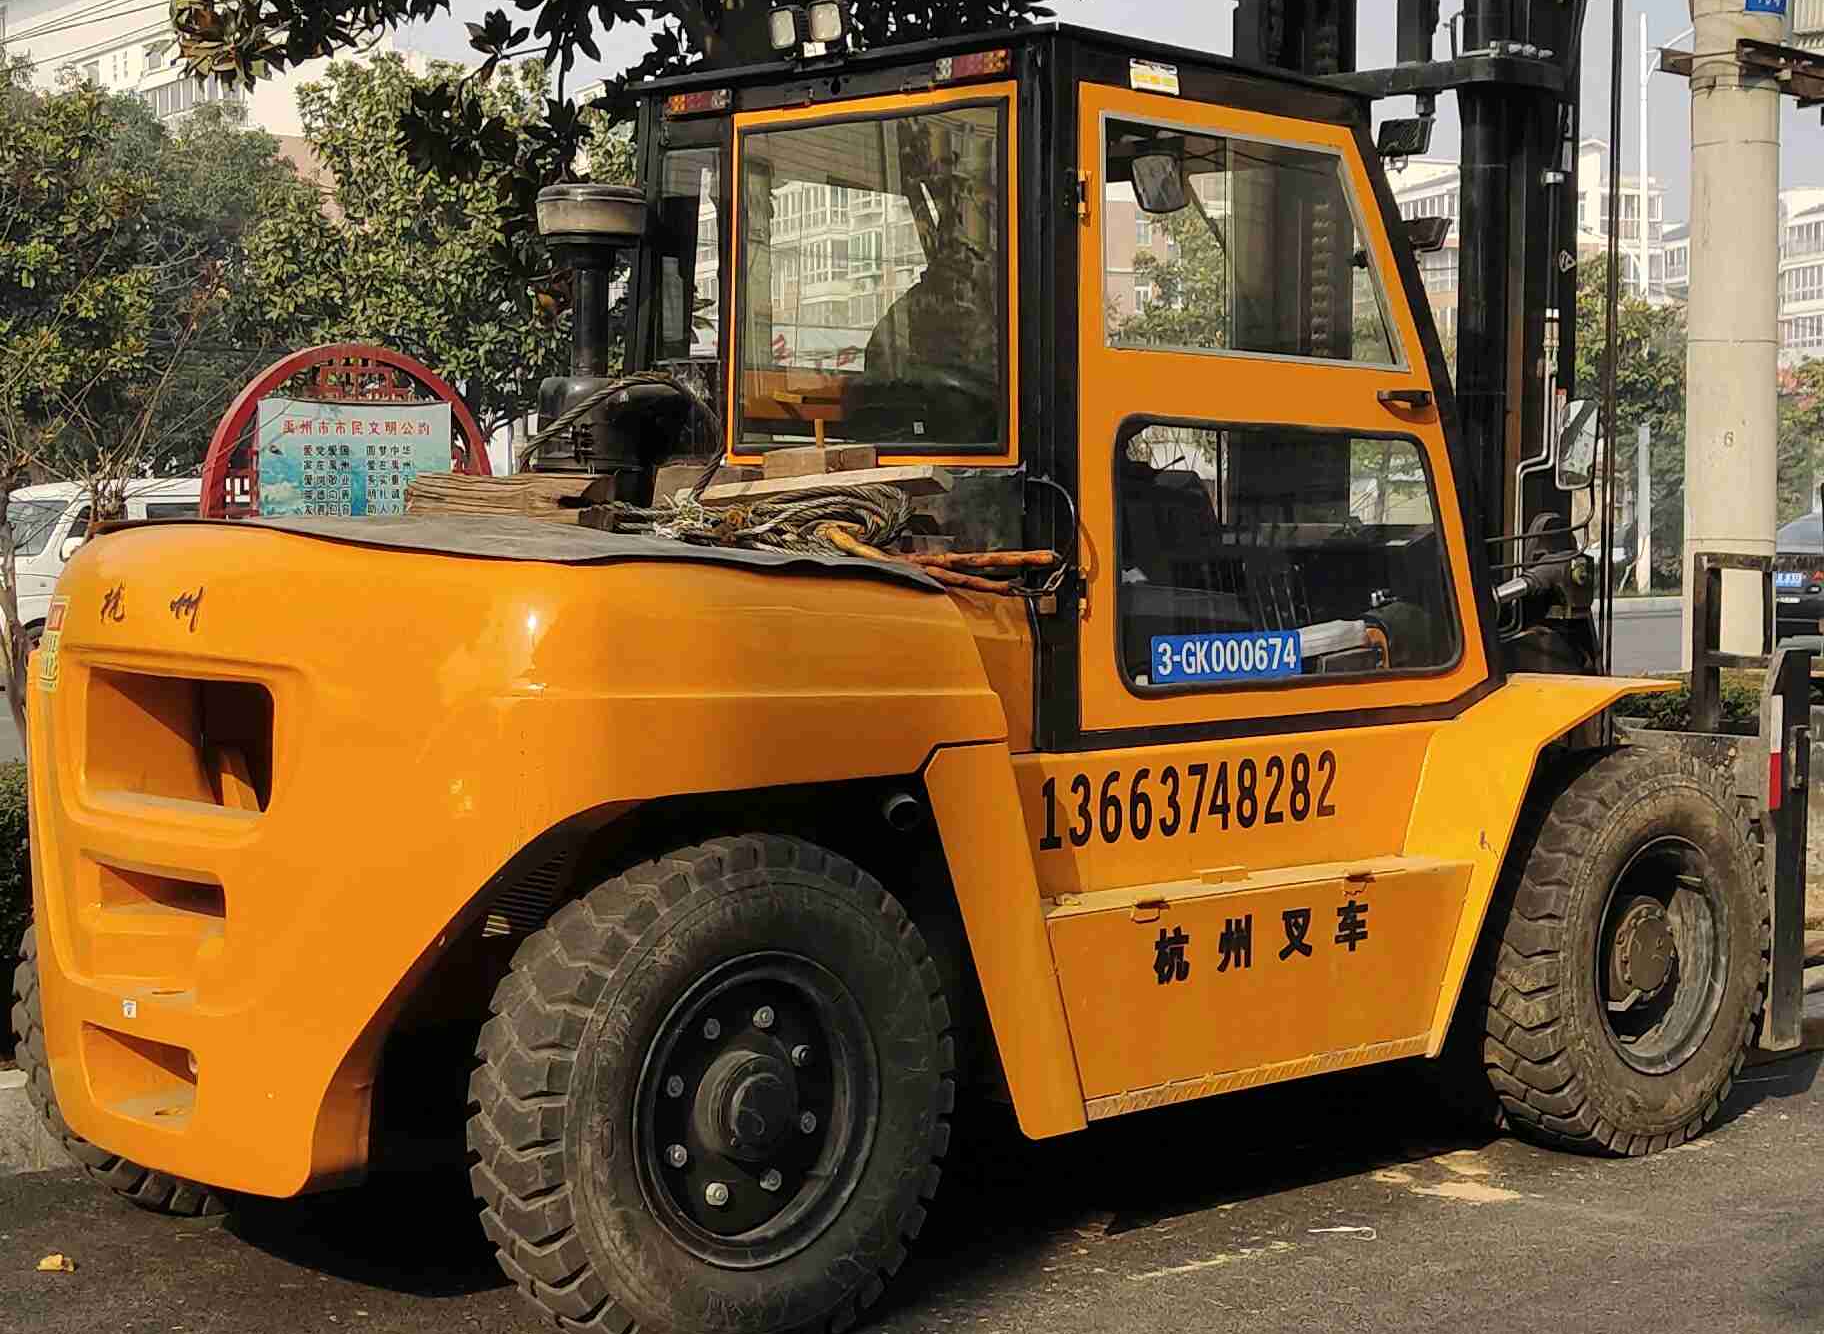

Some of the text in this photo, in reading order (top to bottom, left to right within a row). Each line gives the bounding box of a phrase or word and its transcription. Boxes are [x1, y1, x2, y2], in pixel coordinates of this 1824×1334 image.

[282, 419, 431, 436] 禹州市市民文明公约
[1158, 636, 1296, 675] 3-GK000674
[1040, 750, 1336, 851] 13663748282
[1153, 900, 1369, 985] 杭州叉车
